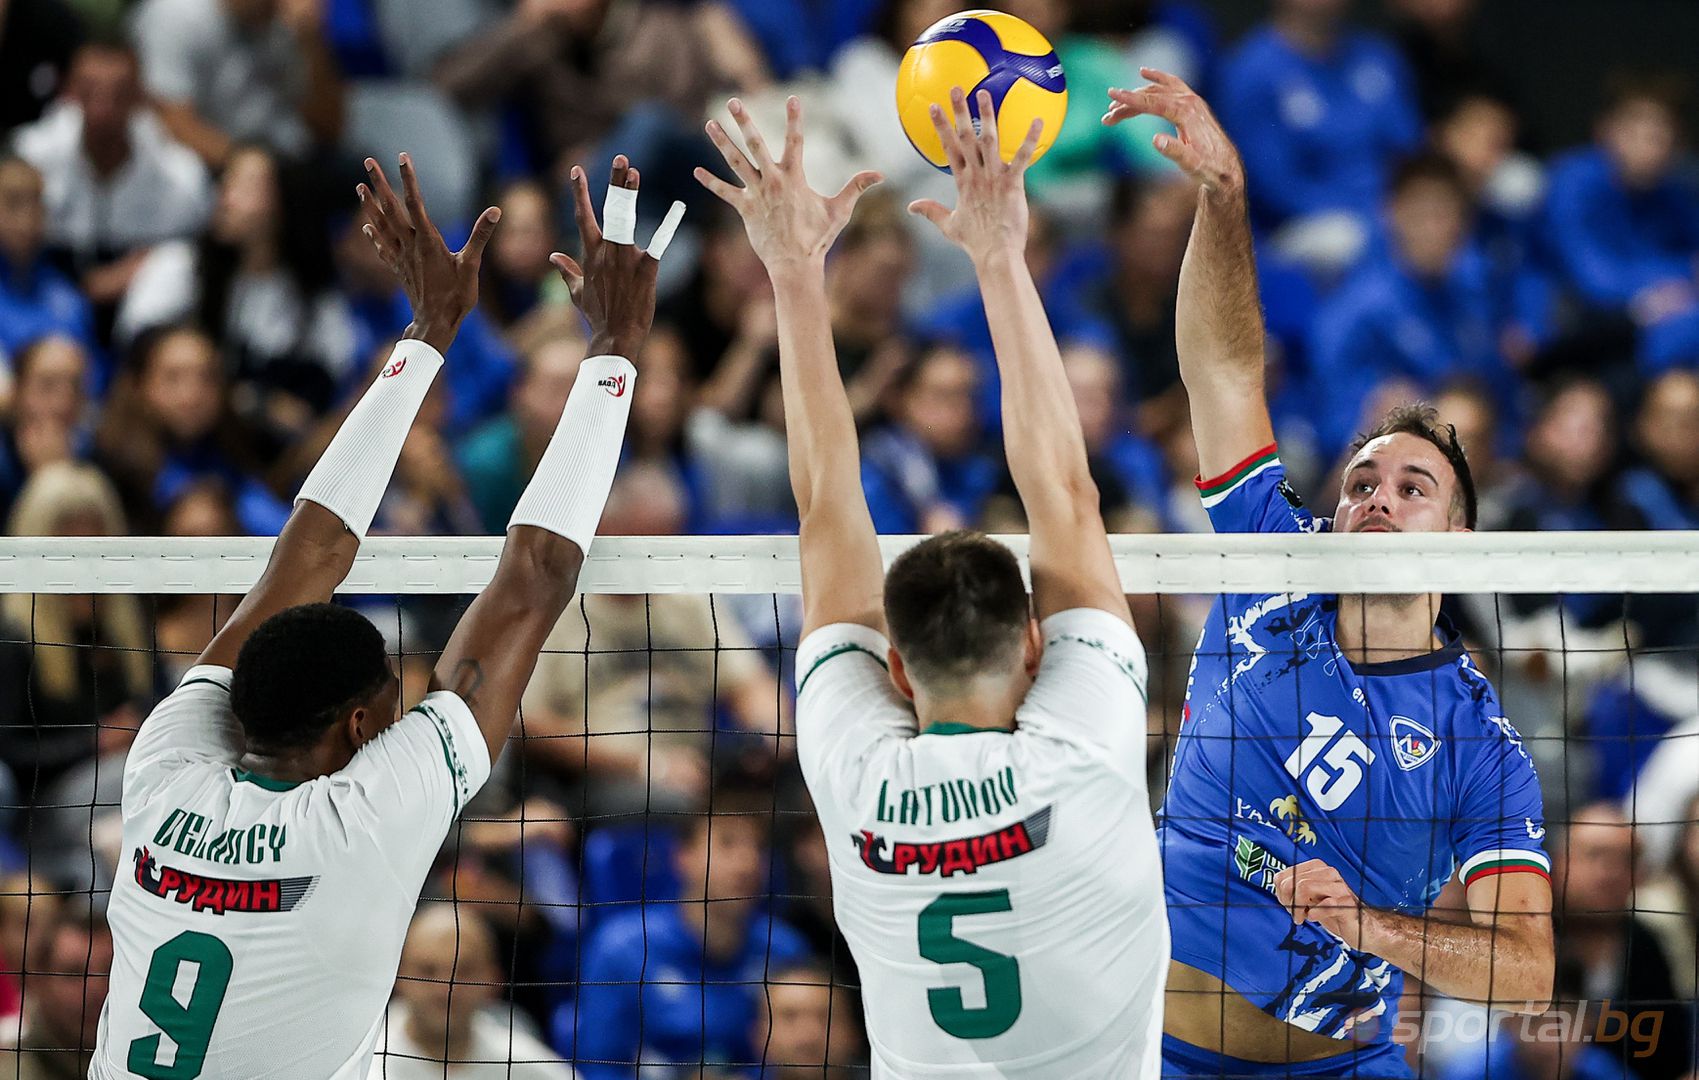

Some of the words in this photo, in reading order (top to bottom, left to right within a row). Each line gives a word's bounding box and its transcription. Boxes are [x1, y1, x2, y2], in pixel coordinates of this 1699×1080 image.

[1284, 711, 1376, 811] 15
[127, 930, 234, 1080] 9
[918, 888, 1022, 1039] 5
